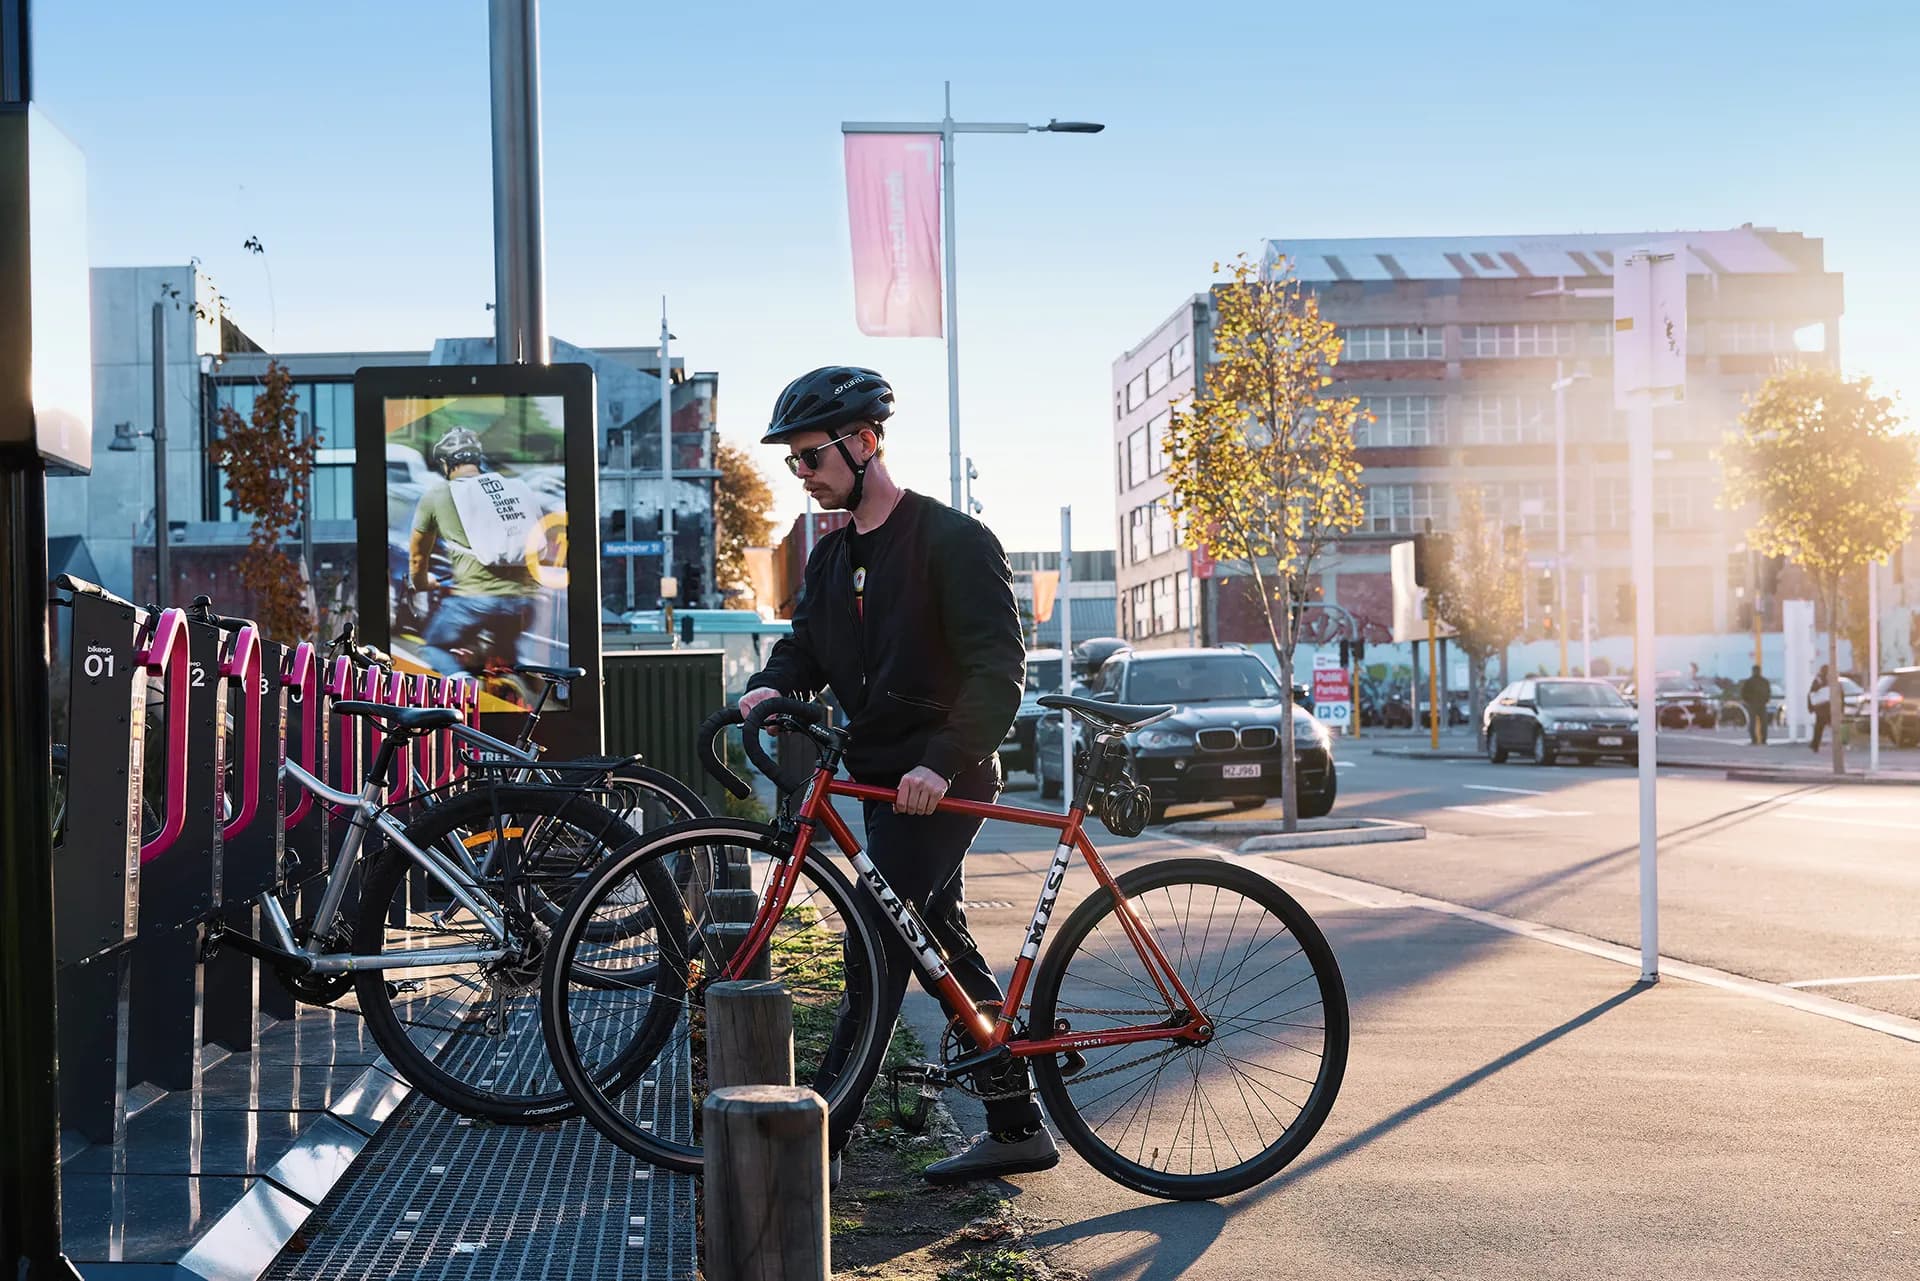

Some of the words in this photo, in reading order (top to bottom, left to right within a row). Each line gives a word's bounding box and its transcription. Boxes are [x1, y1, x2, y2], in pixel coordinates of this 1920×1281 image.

[482, 480, 503, 493] NO
[493, 497, 520, 507] SHORT
[496, 506, 515, 514] CAR
[500, 512, 526, 521] TRIPS
[84, 655, 114, 677] 01
[1316, 671, 1342, 682] Public
[1316, 684, 1349, 697] Parking
[1224, 766, 1259, 777] HZJ961
[1028, 858, 1069, 945] MASI
[864, 867, 929, 955] MASI
[1074, 1038, 1101, 1047] MASI
